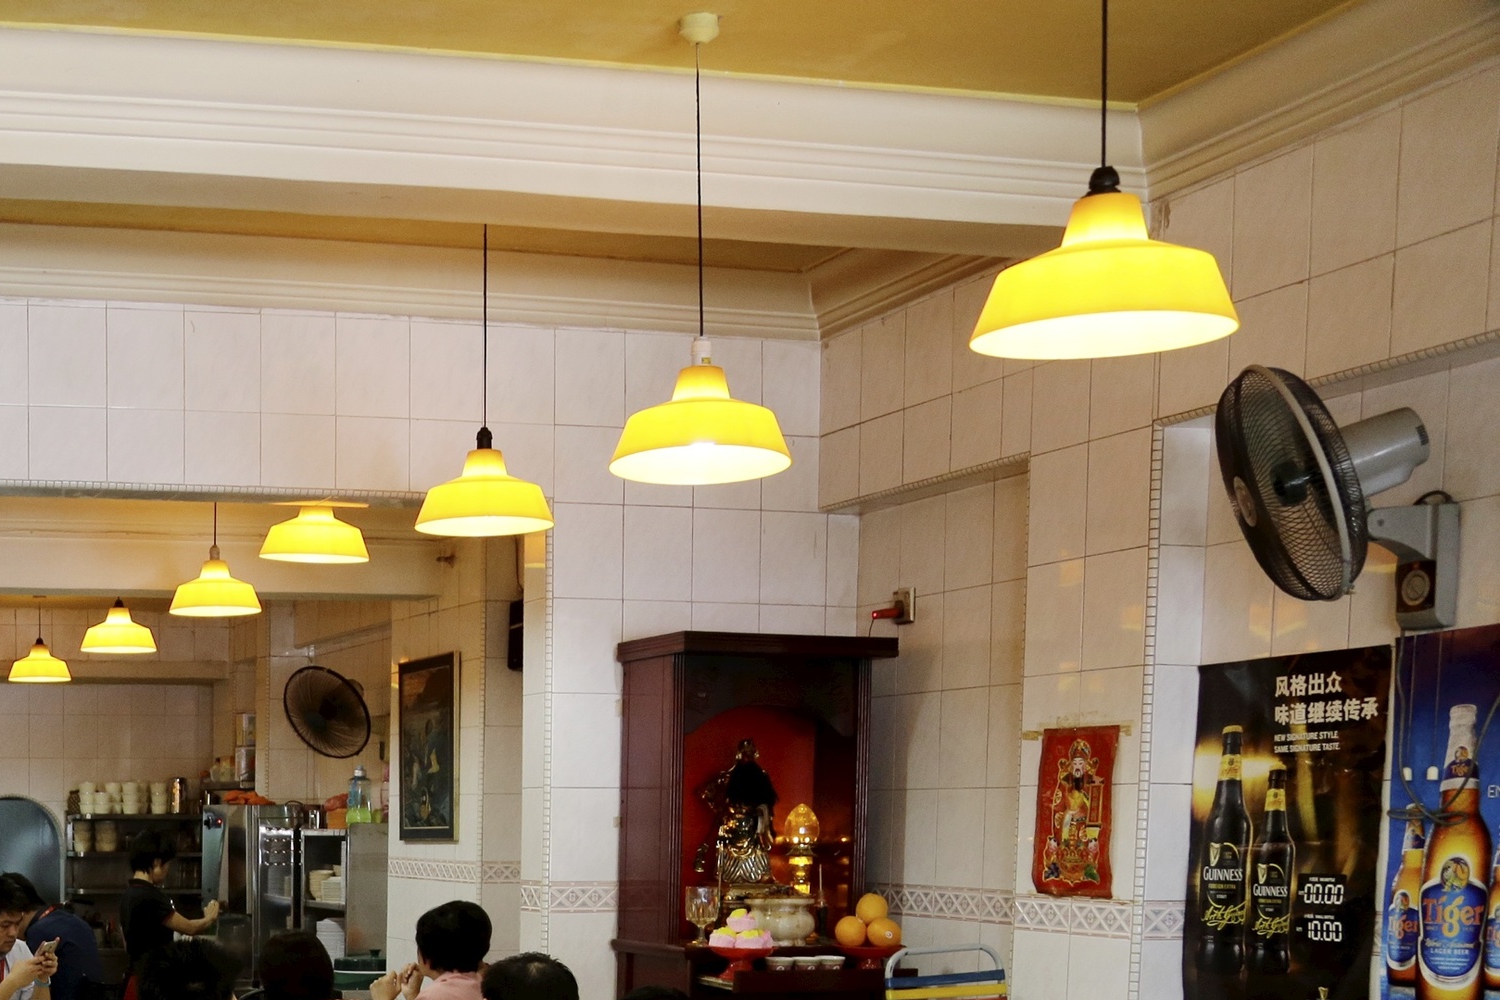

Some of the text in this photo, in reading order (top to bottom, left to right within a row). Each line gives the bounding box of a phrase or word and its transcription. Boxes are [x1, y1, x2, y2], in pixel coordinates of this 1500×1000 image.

[1275, 671, 1342, 697] 风格出众
[1274, 697, 1379, 725] 味道继续传承
[1203, 866, 1243, 882] GUINNESS
[1252, 884, 1288, 897] GUINNESS
[1303, 883, 1344, 905] 00.00
[1422, 895, 1485, 938] Tiger
[1307, 920, 1342, 942] 10.00
